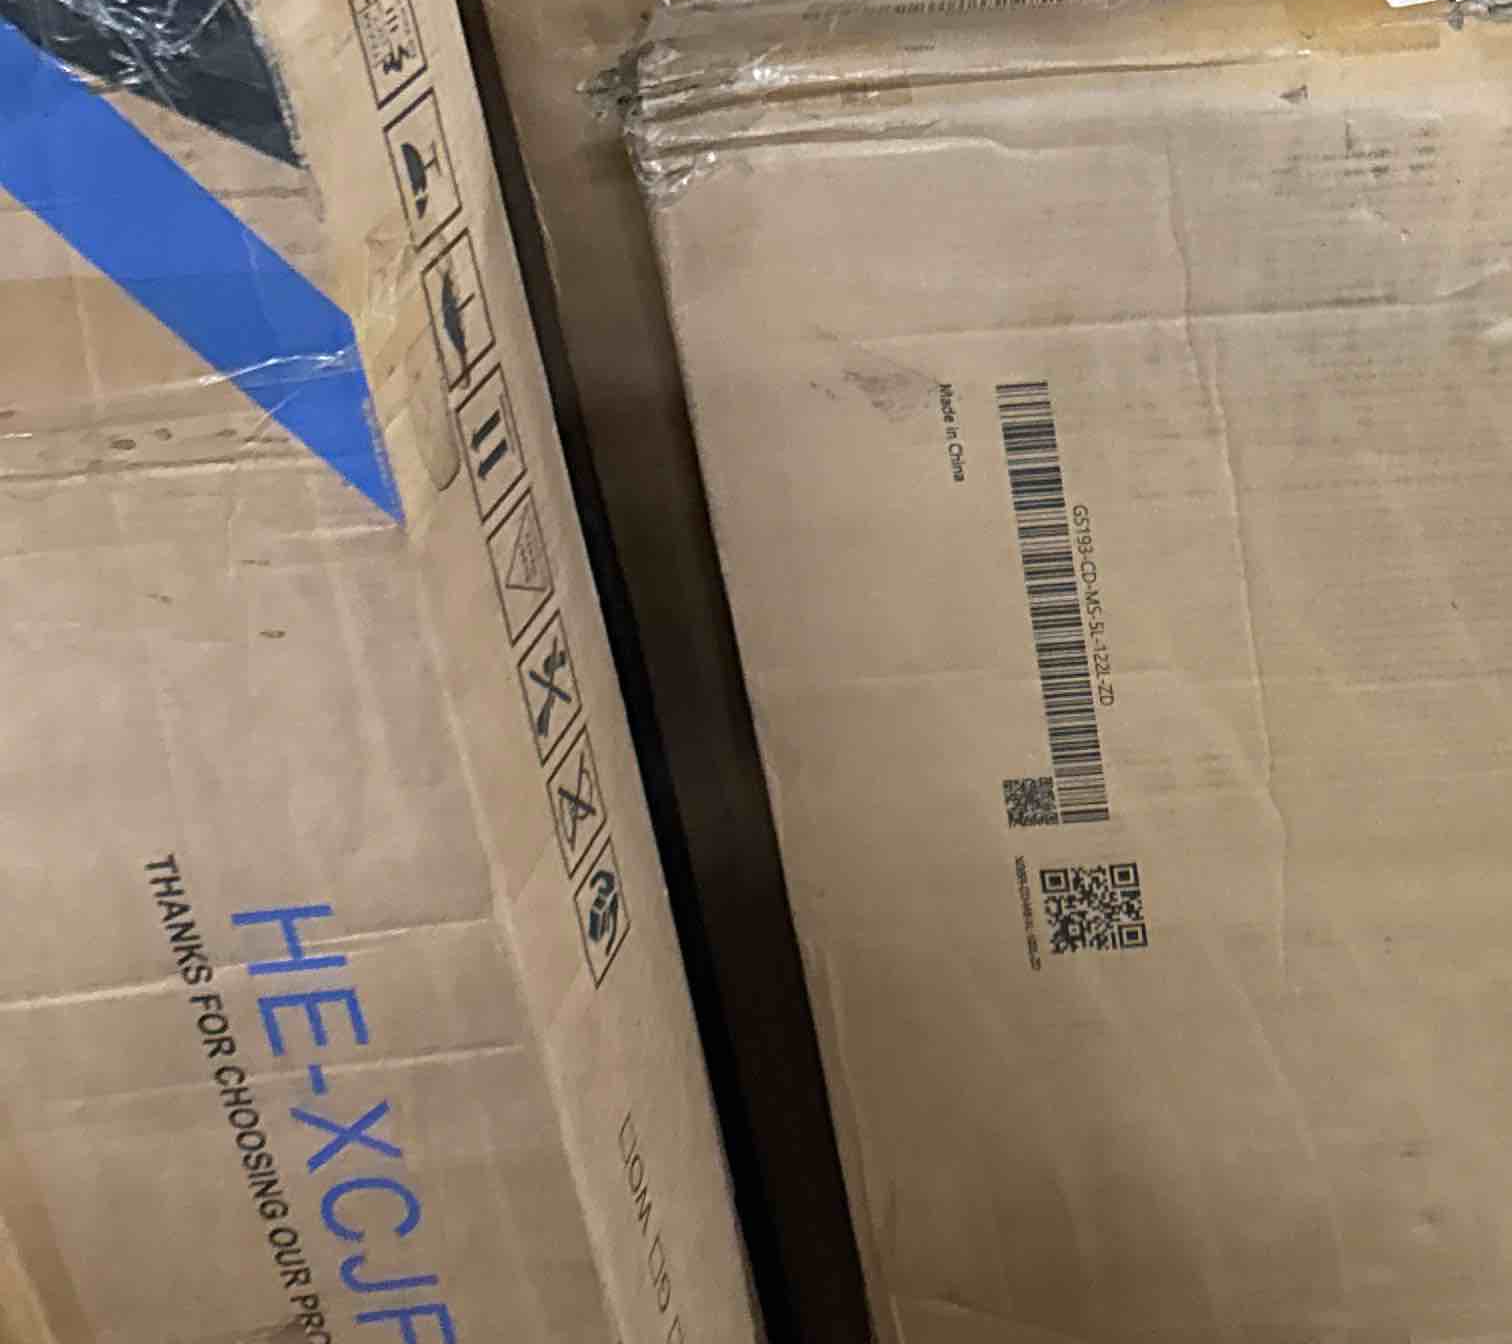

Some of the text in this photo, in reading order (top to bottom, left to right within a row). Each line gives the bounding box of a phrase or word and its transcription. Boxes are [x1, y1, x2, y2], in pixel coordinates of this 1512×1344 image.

[939, 383, 966, 483] Made in China
[144, 853, 216, 986] THANKS
[189, 993, 233, 1061] FOR
[214, 1065, 289, 1224] CHOOSING
[269, 1222, 313, 1291] OUR
